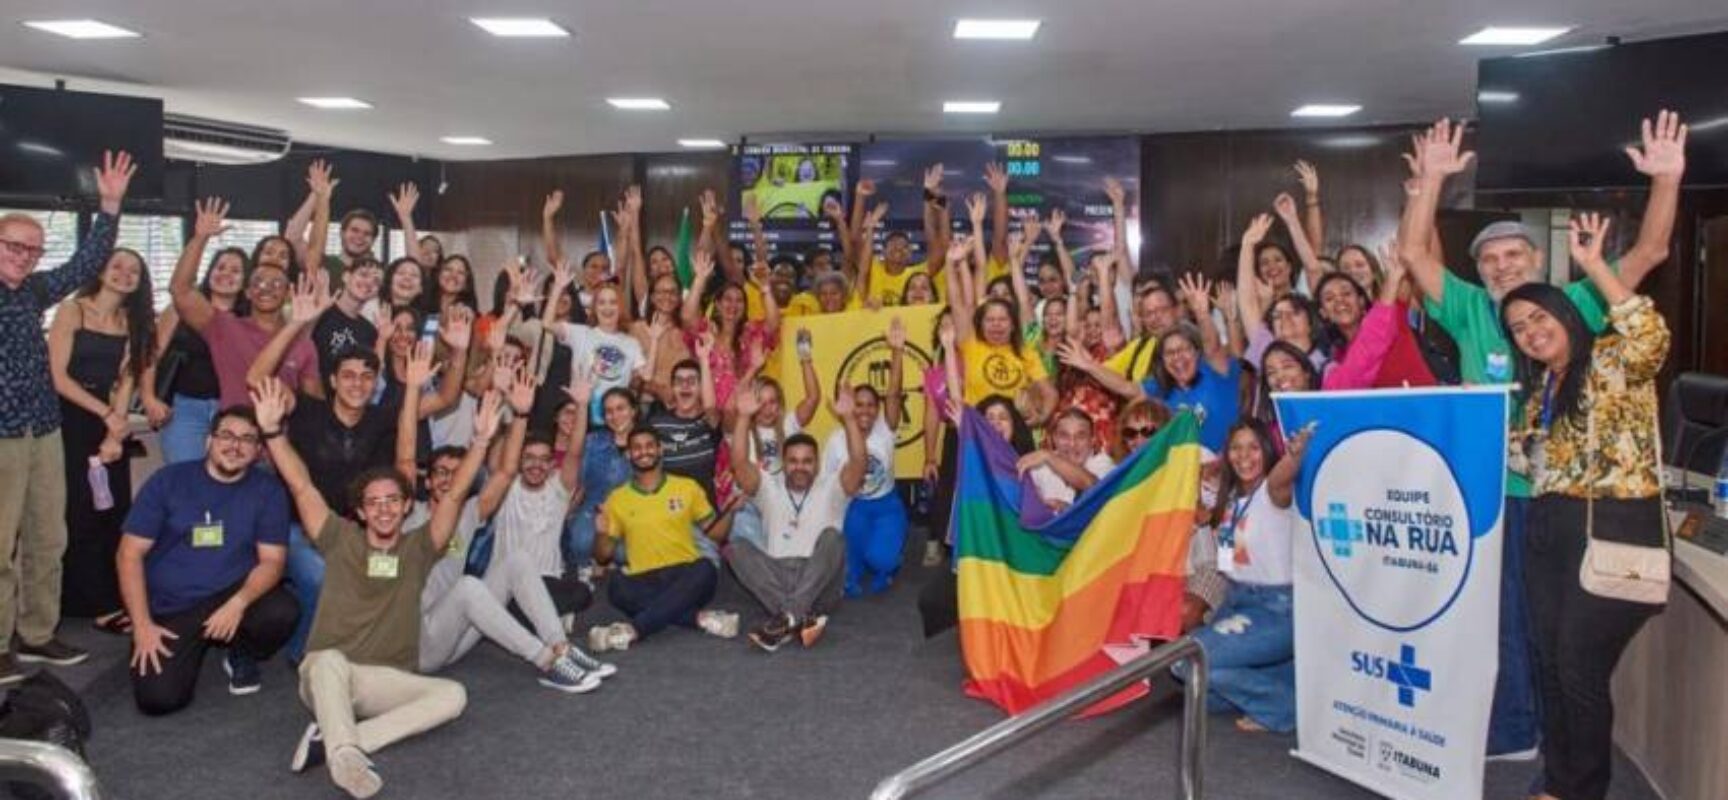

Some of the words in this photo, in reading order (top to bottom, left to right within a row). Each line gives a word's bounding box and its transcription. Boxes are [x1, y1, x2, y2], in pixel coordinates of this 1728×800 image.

[1386, 489, 1430, 504] EQUIPE
[1364, 508, 1454, 529] CONSULTÓRIO
[1366, 521, 1400, 549] NA
[1407, 525, 1459, 556] RUA
[1351, 651, 1385, 679] SUS
[1393, 751, 1440, 779] ITABUNA
